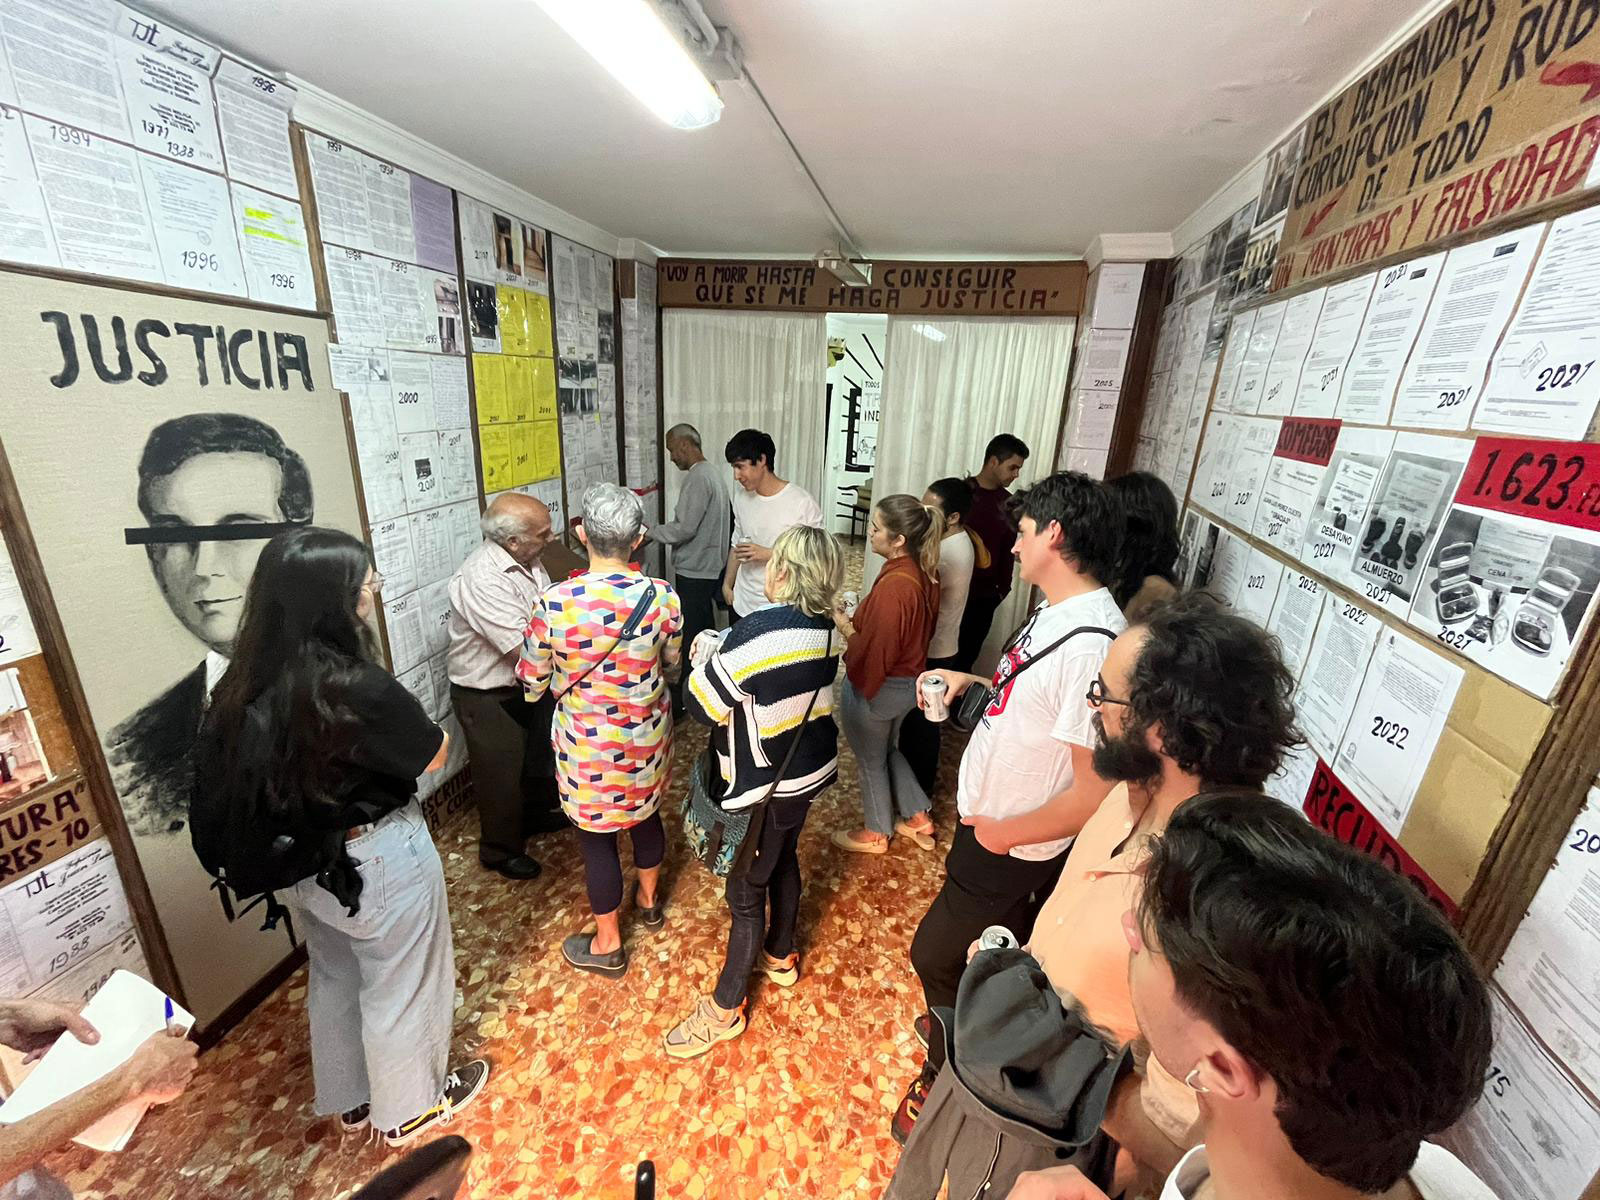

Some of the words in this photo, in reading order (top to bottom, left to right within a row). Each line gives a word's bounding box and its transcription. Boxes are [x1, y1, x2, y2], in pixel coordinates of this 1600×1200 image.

[252, 76, 276, 93] 1996
[1446, 44, 1485, 122] Y
[50, 125, 91, 147] 1994
[1356, 165, 1388, 214] DE
[1405, 105, 1493, 195] TODO
[1302, 204, 1404, 278] MENTIRAS
[1399, 193, 1428, 250] Y
[181, 250, 219, 271] 1996
[270, 273, 296, 290] 1996
[694, 266, 706, 283] A
[713, 266, 748, 284] MORIR
[756, 267, 815, 286] HASTA
[883, 268, 1017, 289] CONSEGUIR
[696, 285, 734, 304] QUE
[745, 285, 766, 304] SE
[778, 287, 807, 305] ME
[828, 288, 901, 309] HAGA
[40, 311, 314, 392] JUSTICIA
[1321, 366, 1339, 391] 2021
[1536, 360, 1596, 392] 2021
[398, 392, 419, 404] 2000
[1437, 385, 1472, 409] 2021
[1321, 525, 1353, 546] DESAYUNO
[1313, 542, 1336, 559] 2021
[1247, 575, 1265, 589] 2022
[1361, 560, 1404, 585] ALMUERZO
[1299, 575, 1319, 594] 2022
[1365, 582, 1393, 605] 2021
[1342, 603, 1368, 626] 2022
[1437, 625, 1473, 651] 2021
[1371, 715, 1410, 751] 2022
